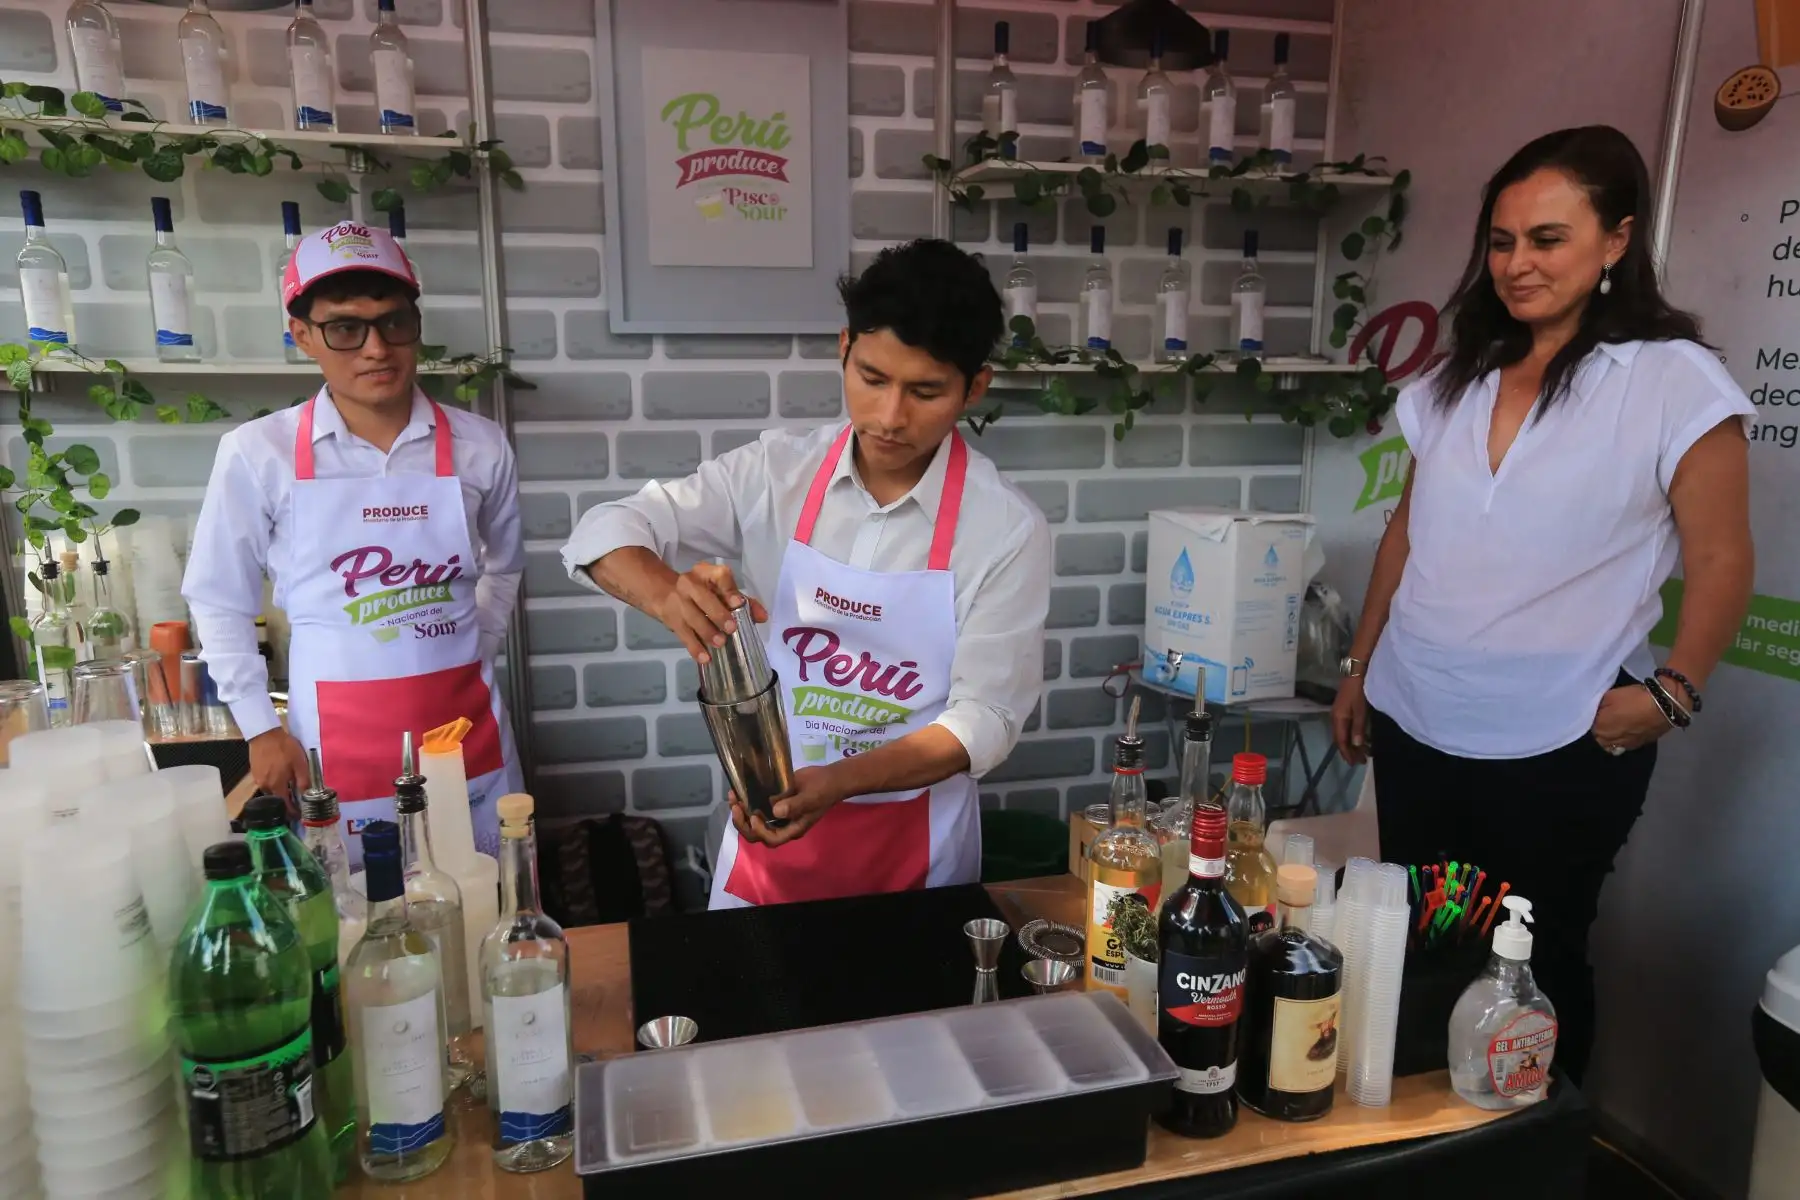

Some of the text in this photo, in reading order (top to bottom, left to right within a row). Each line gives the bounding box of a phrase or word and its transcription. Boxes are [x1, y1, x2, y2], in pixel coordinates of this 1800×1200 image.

[660, 92, 792, 152] Perú
[686, 151, 780, 182] produce
[738, 204, 788, 221] Sour
[321, 224, 371, 243] Perú
[362, 505, 429, 518] PRODUCE
[330, 545, 464, 598] Perú
[358, 585, 446, 625] produce
[815, 587, 883, 617] PRODUCE
[387, 607, 443, 627] Nacional del
[414, 621, 458, 639] Sour
[1746, 614, 1800, 638] medi
[782, 626, 924, 701] Perú
[800, 691, 900, 725] produce
[1176, 966, 1246, 994] CINZANO
[1190, 989, 1237, 1004] Vermouth
[1495, 1040, 1509, 1052] GEL
